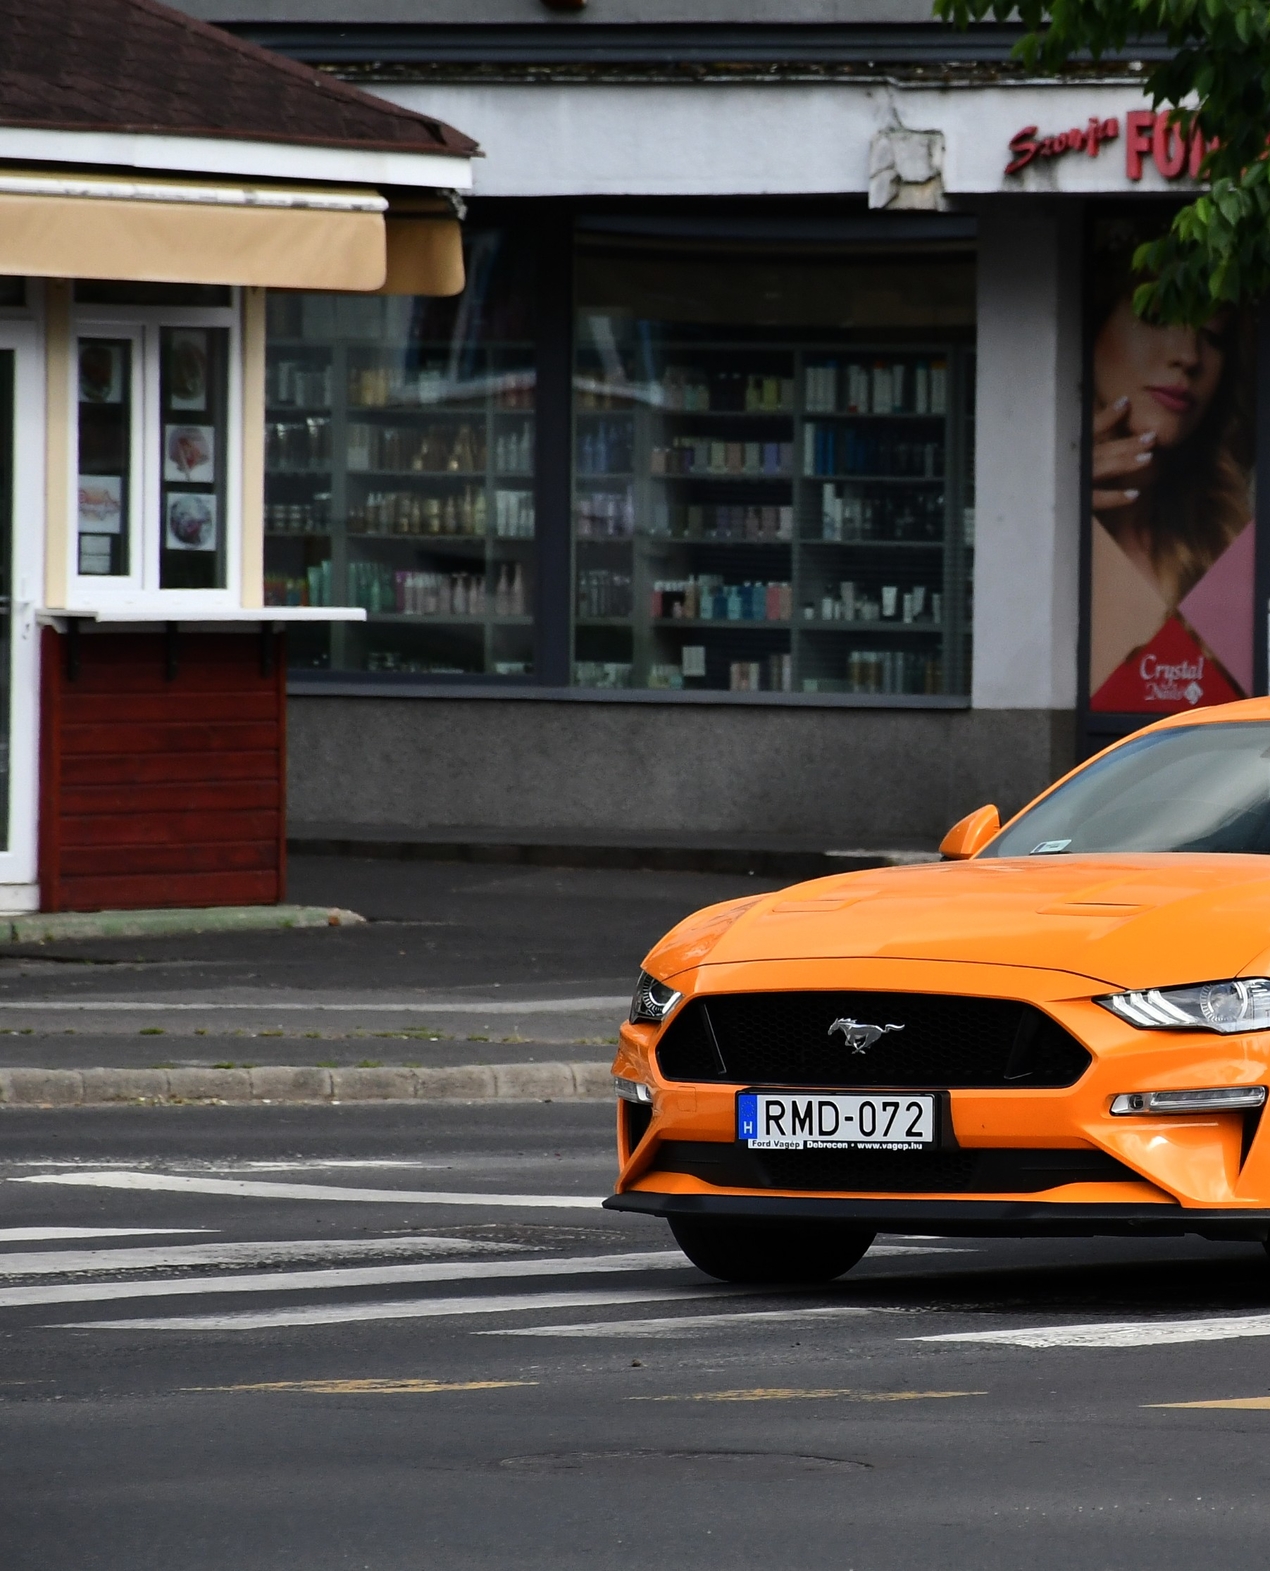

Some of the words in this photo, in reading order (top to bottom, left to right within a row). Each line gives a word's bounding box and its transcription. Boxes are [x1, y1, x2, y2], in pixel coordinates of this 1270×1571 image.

[1004, 116, 1119, 174] Szonja
[1139, 653, 1205, 687] Crystal
[743, 1121, 753, 1134] H
[765, 1100, 924, 1137] RMD-072
[807, 1141, 848, 1149] Debrecen
[857, 1142, 923, 1151] www.vagep.hu
